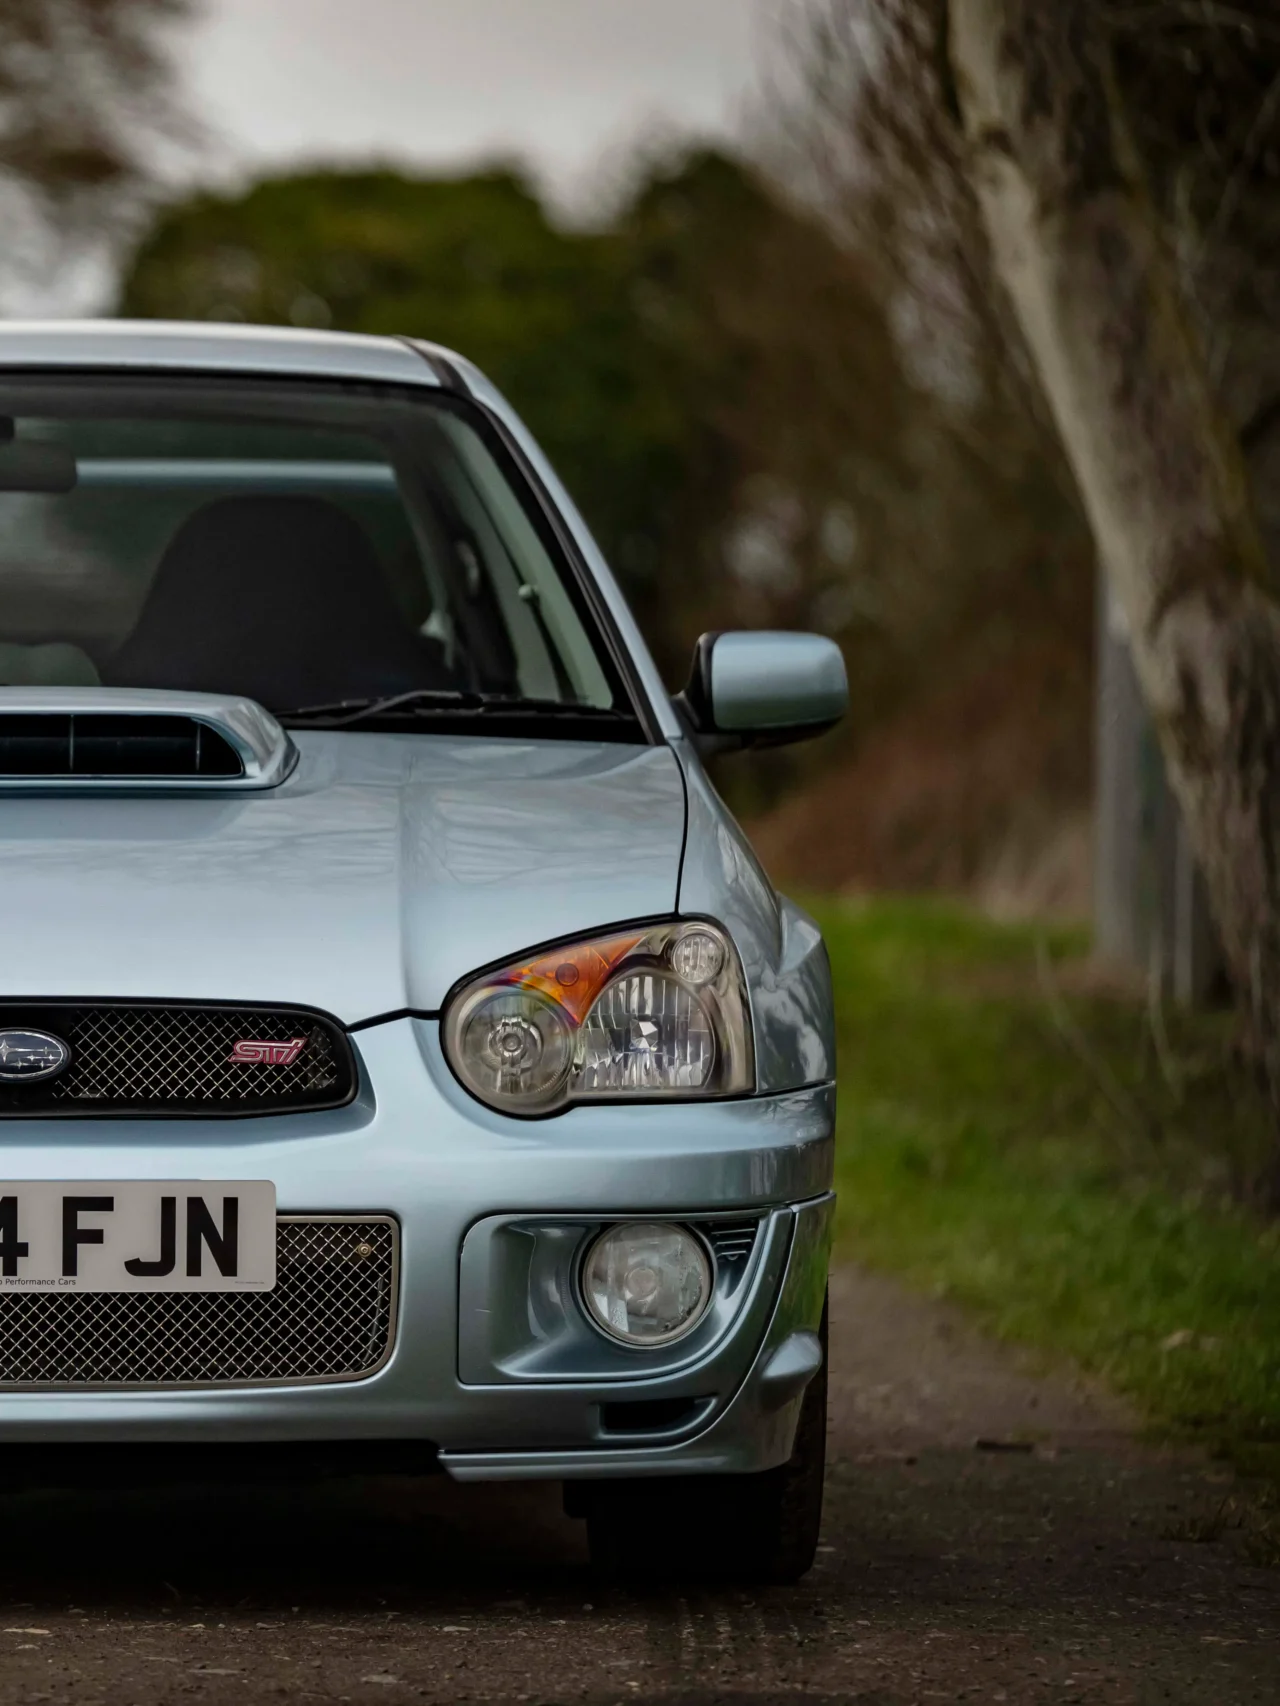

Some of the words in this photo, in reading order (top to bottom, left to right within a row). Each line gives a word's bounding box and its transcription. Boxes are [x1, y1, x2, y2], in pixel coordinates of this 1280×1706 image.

[62, 1196, 238, 1277] FJN
[5, 1278, 55, 1286] Performance
[58, 1278, 76, 1286] Cars
